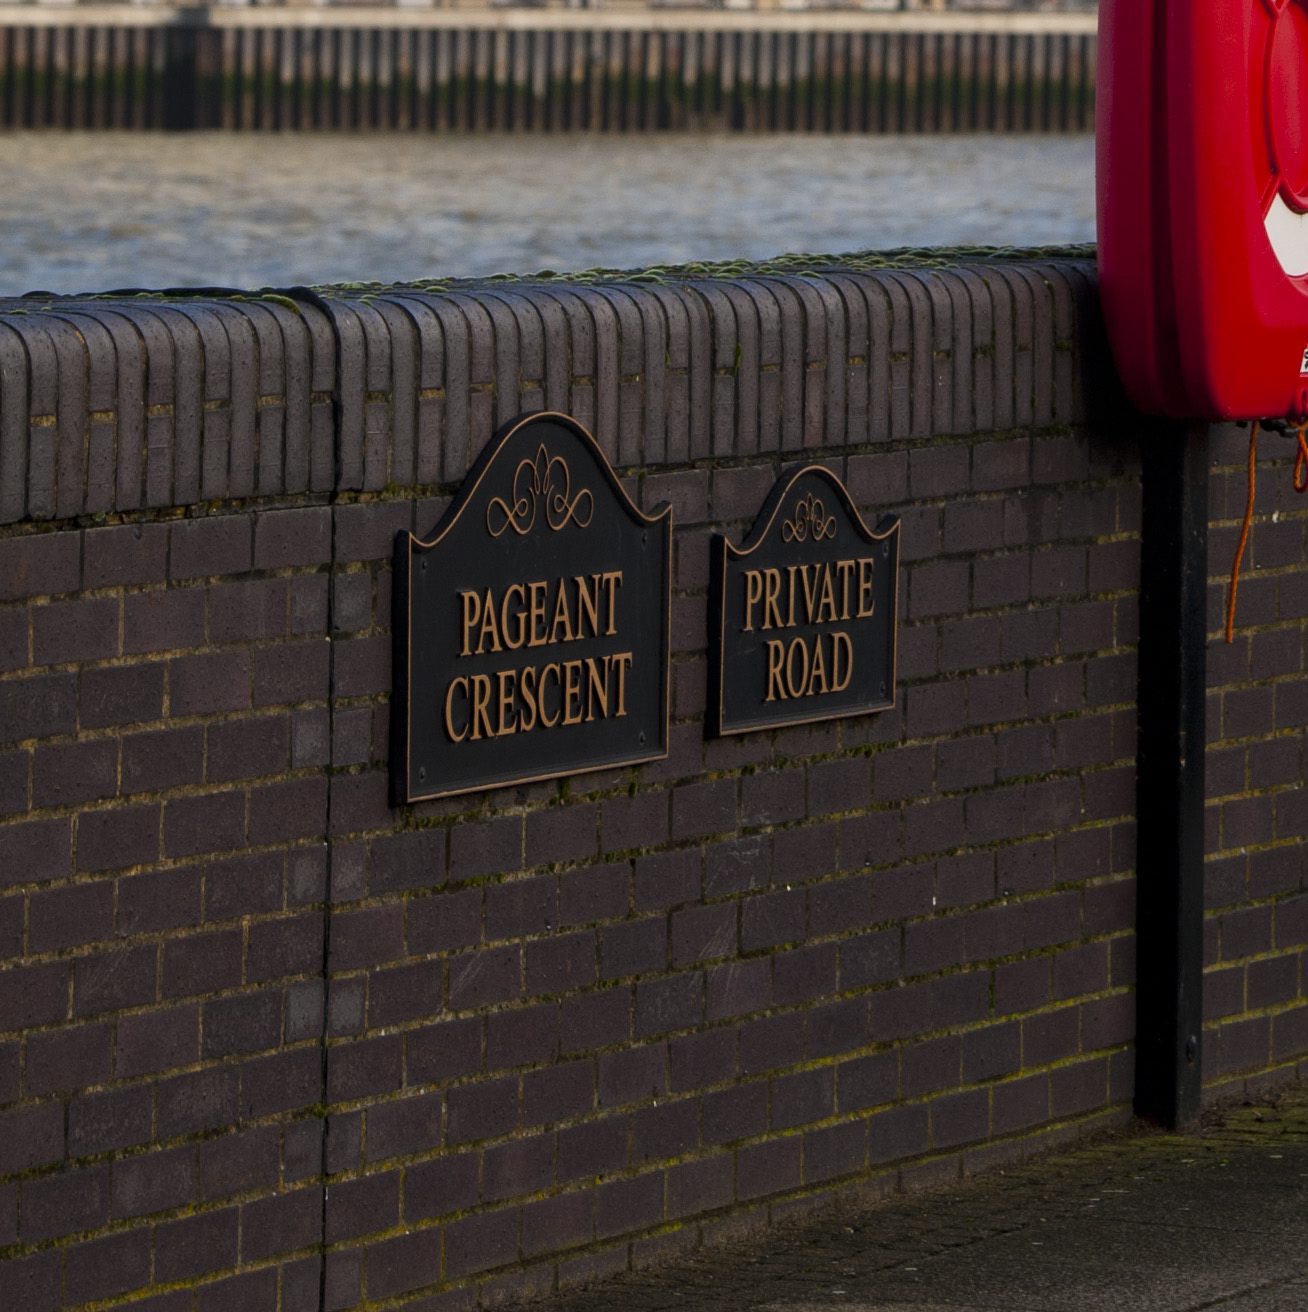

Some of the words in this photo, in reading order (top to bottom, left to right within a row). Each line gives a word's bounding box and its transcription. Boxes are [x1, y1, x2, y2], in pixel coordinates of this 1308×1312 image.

[459, 570, 624, 657] PAGEANT
[742, 557, 876, 632] PRIVATE
[444, 651, 634, 743] CRESCENT
[764, 631, 854, 703] ROAD
